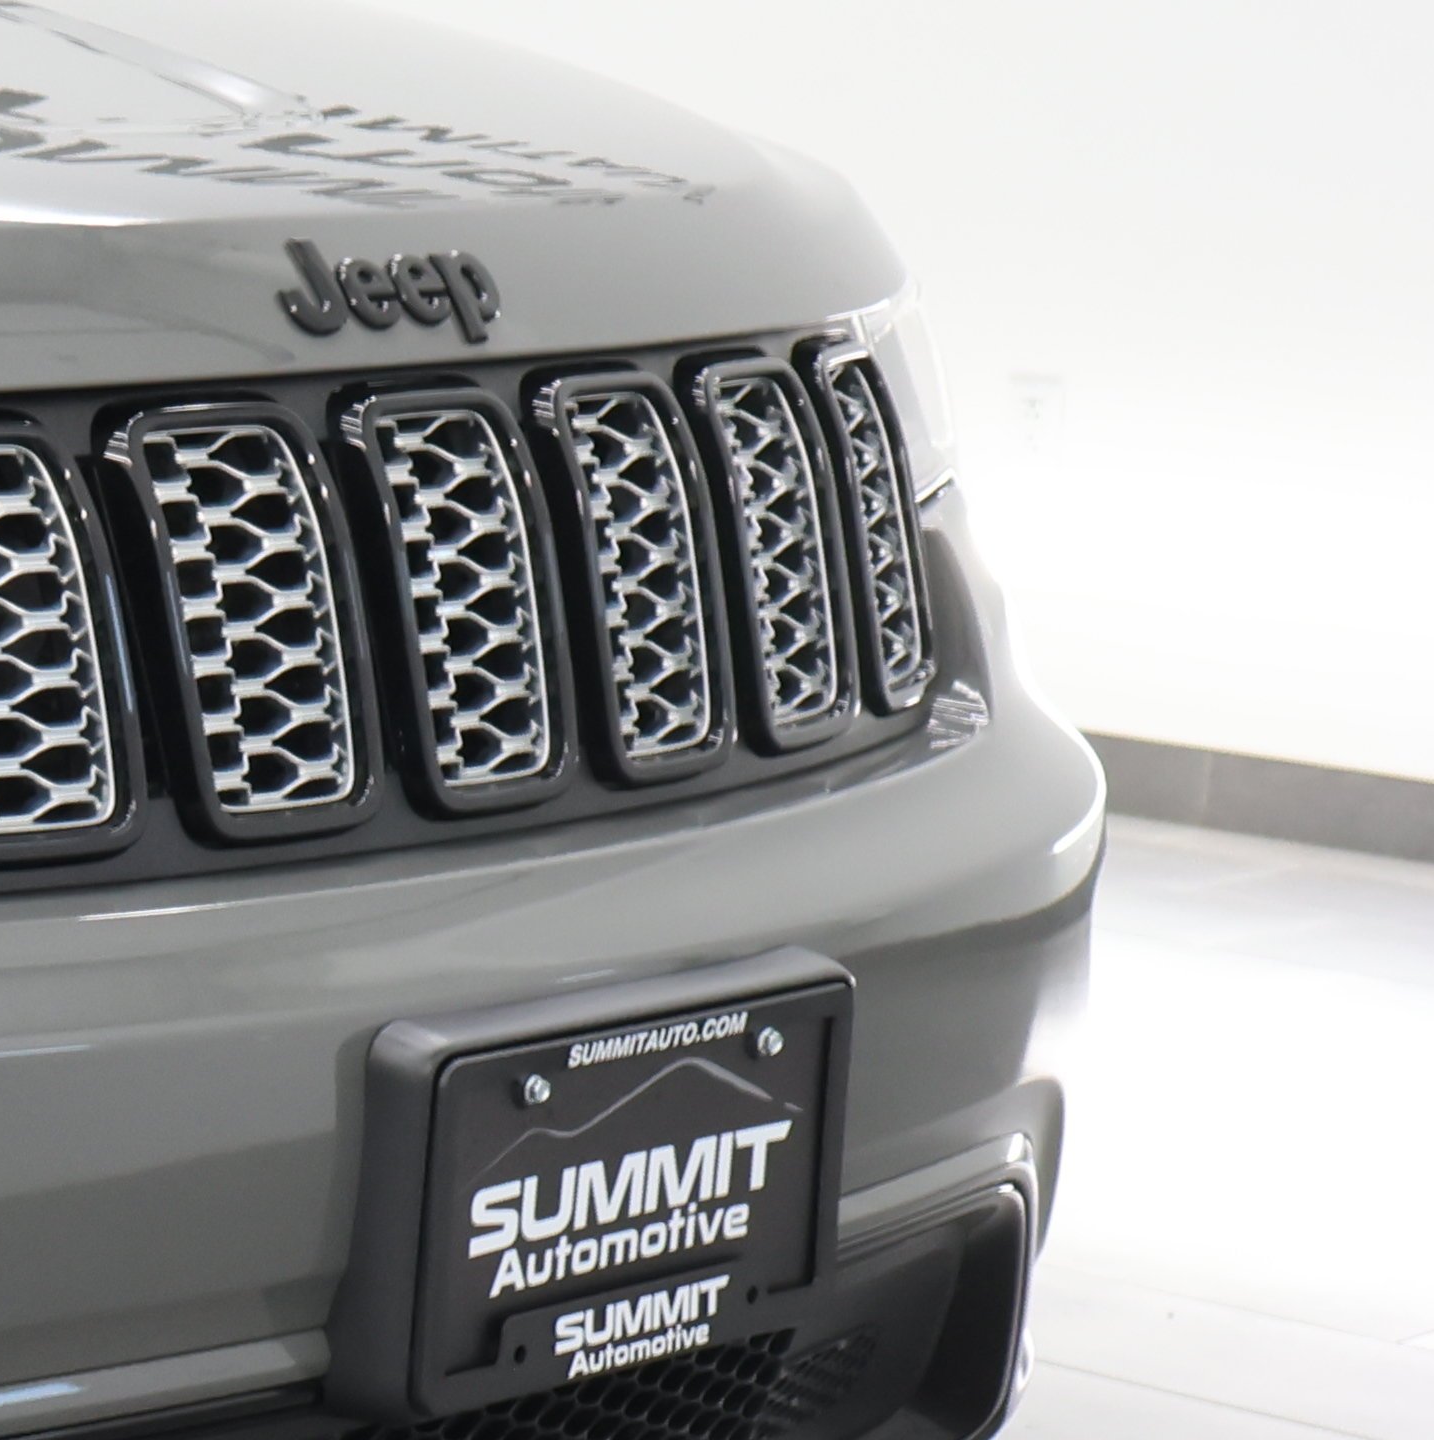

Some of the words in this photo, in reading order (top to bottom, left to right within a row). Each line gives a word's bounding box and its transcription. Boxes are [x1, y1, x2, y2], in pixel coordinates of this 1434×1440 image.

[278, 238, 500, 346] Jeep
[568, 1012, 747, 1068] SUMMITAUTO.COM
[468, 1119, 792, 1259] SUMMIT
[489, 1202, 749, 1298] Automotive
[554, 1274, 730, 1356] SUMMIT
[567, 1323, 710, 1379] Automotive
